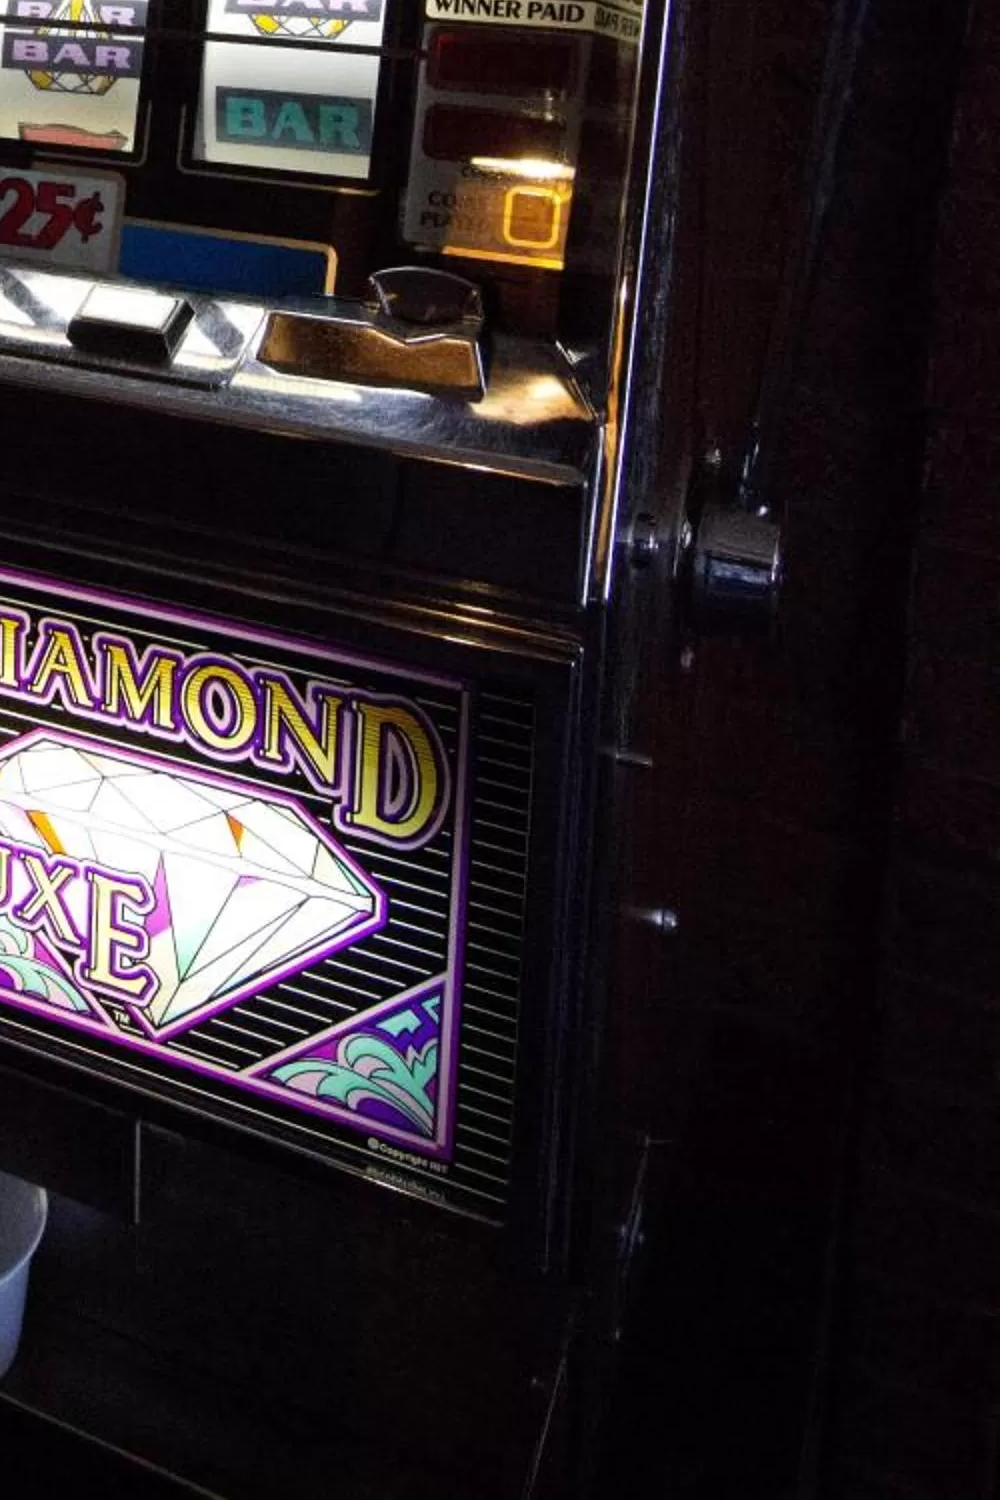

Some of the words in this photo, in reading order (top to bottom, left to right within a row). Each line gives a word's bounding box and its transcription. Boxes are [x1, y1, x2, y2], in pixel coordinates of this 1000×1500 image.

[527, 0, 585, 22] PAID
[12, 39, 132, 69] BAR
[223, 98, 362, 149] BAR
